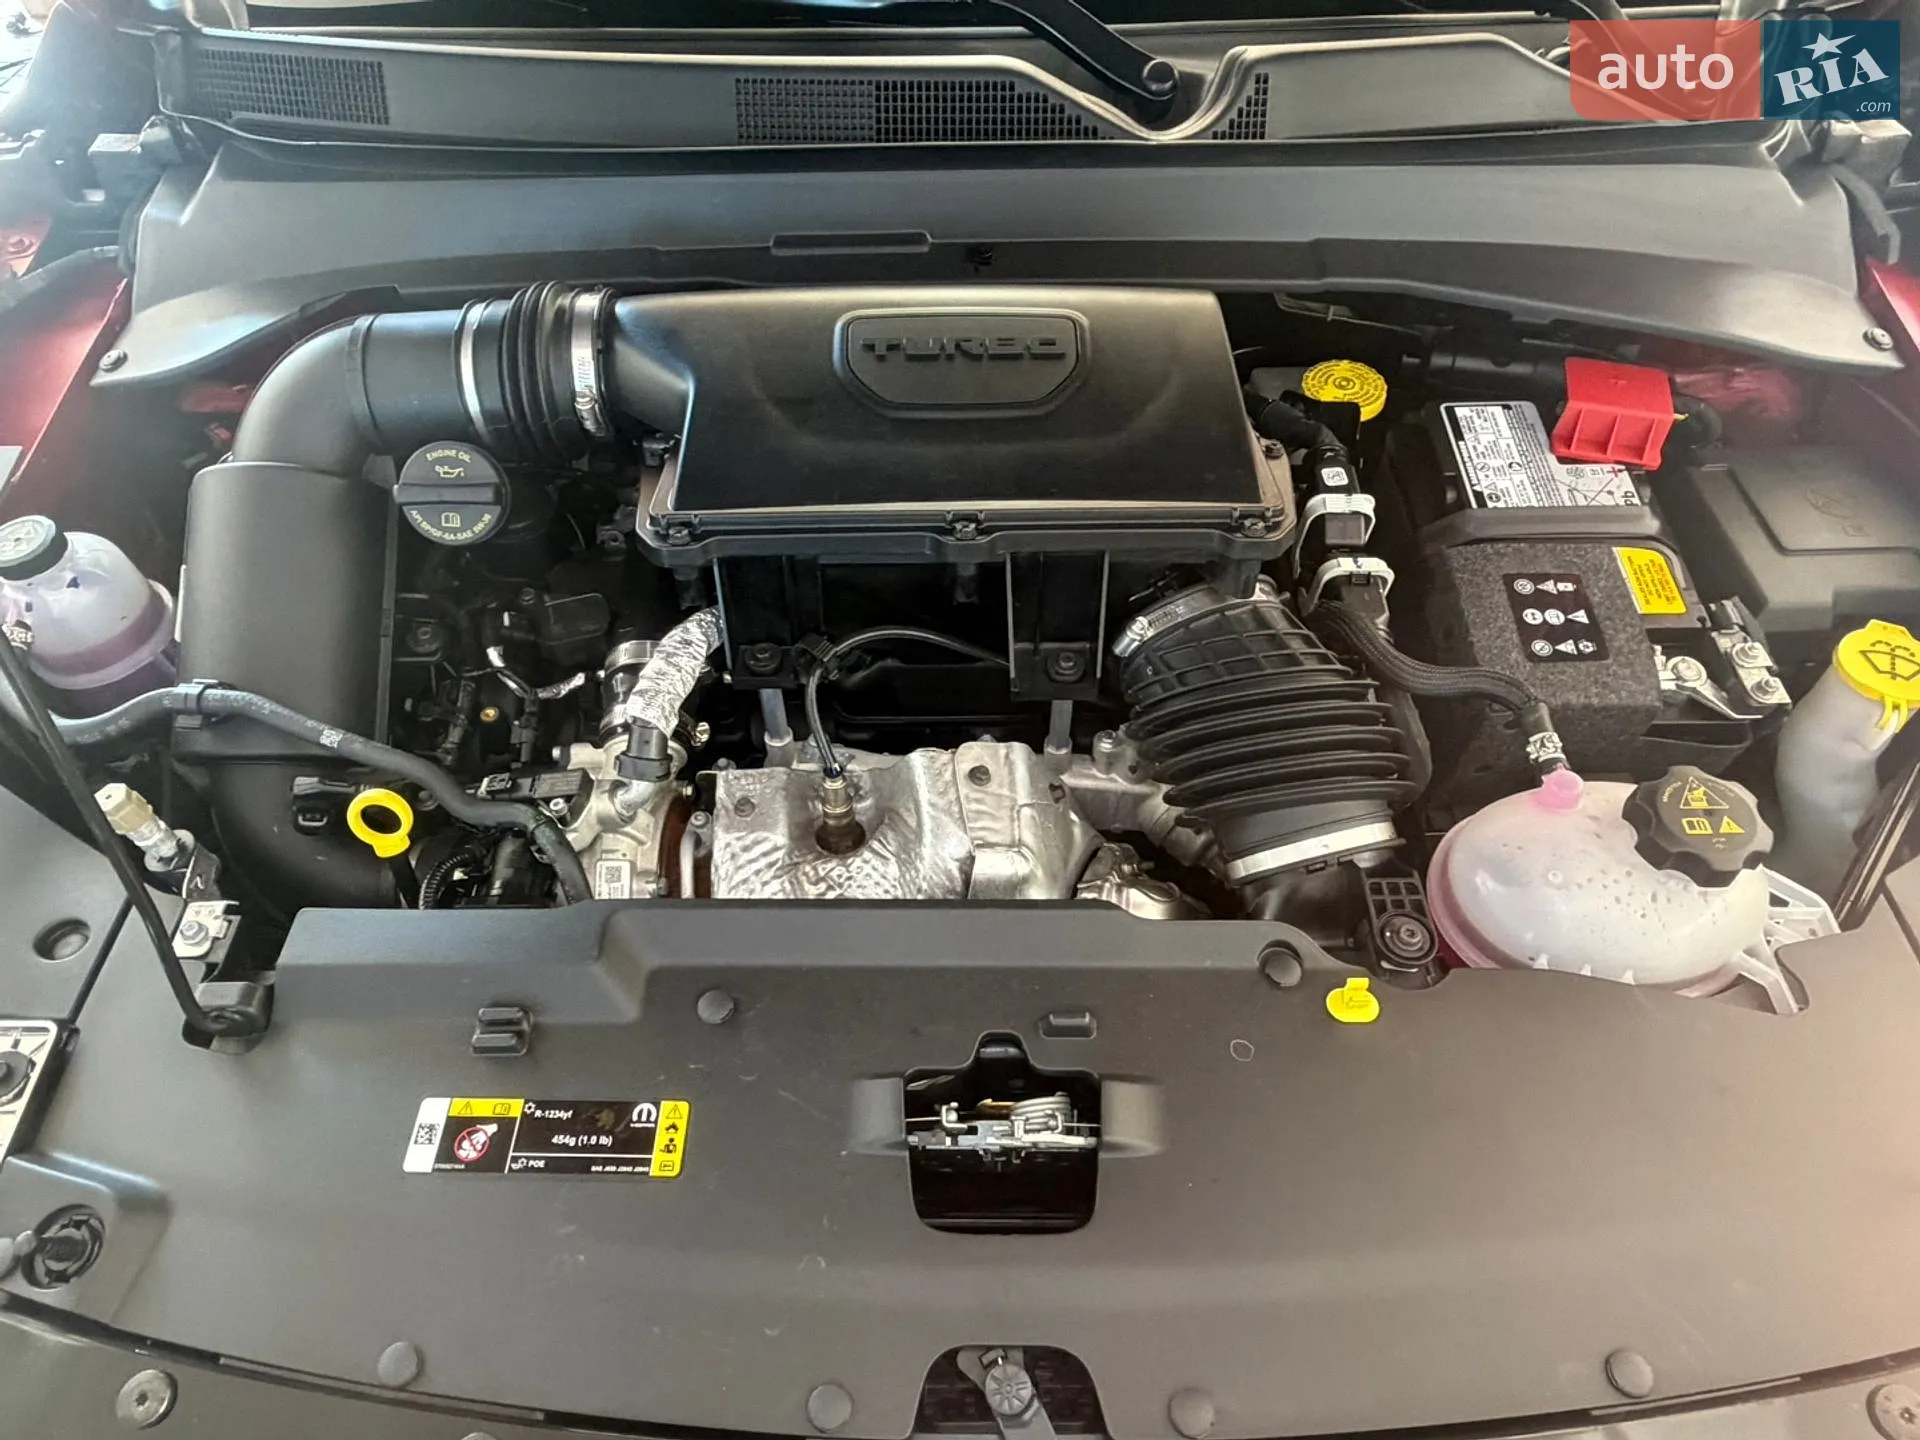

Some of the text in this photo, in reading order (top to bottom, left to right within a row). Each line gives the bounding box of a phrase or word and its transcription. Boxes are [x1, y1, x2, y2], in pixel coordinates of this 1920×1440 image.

[860, 336, 1067, 361] TURBO
[426, 449, 471, 464] ENGINE OIL
[534, 1109, 573, 1121] R-1234yf
[551, 1135, 613, 1147] 454g (1.0 lb)
[528, 1160, 546, 1168] POE
